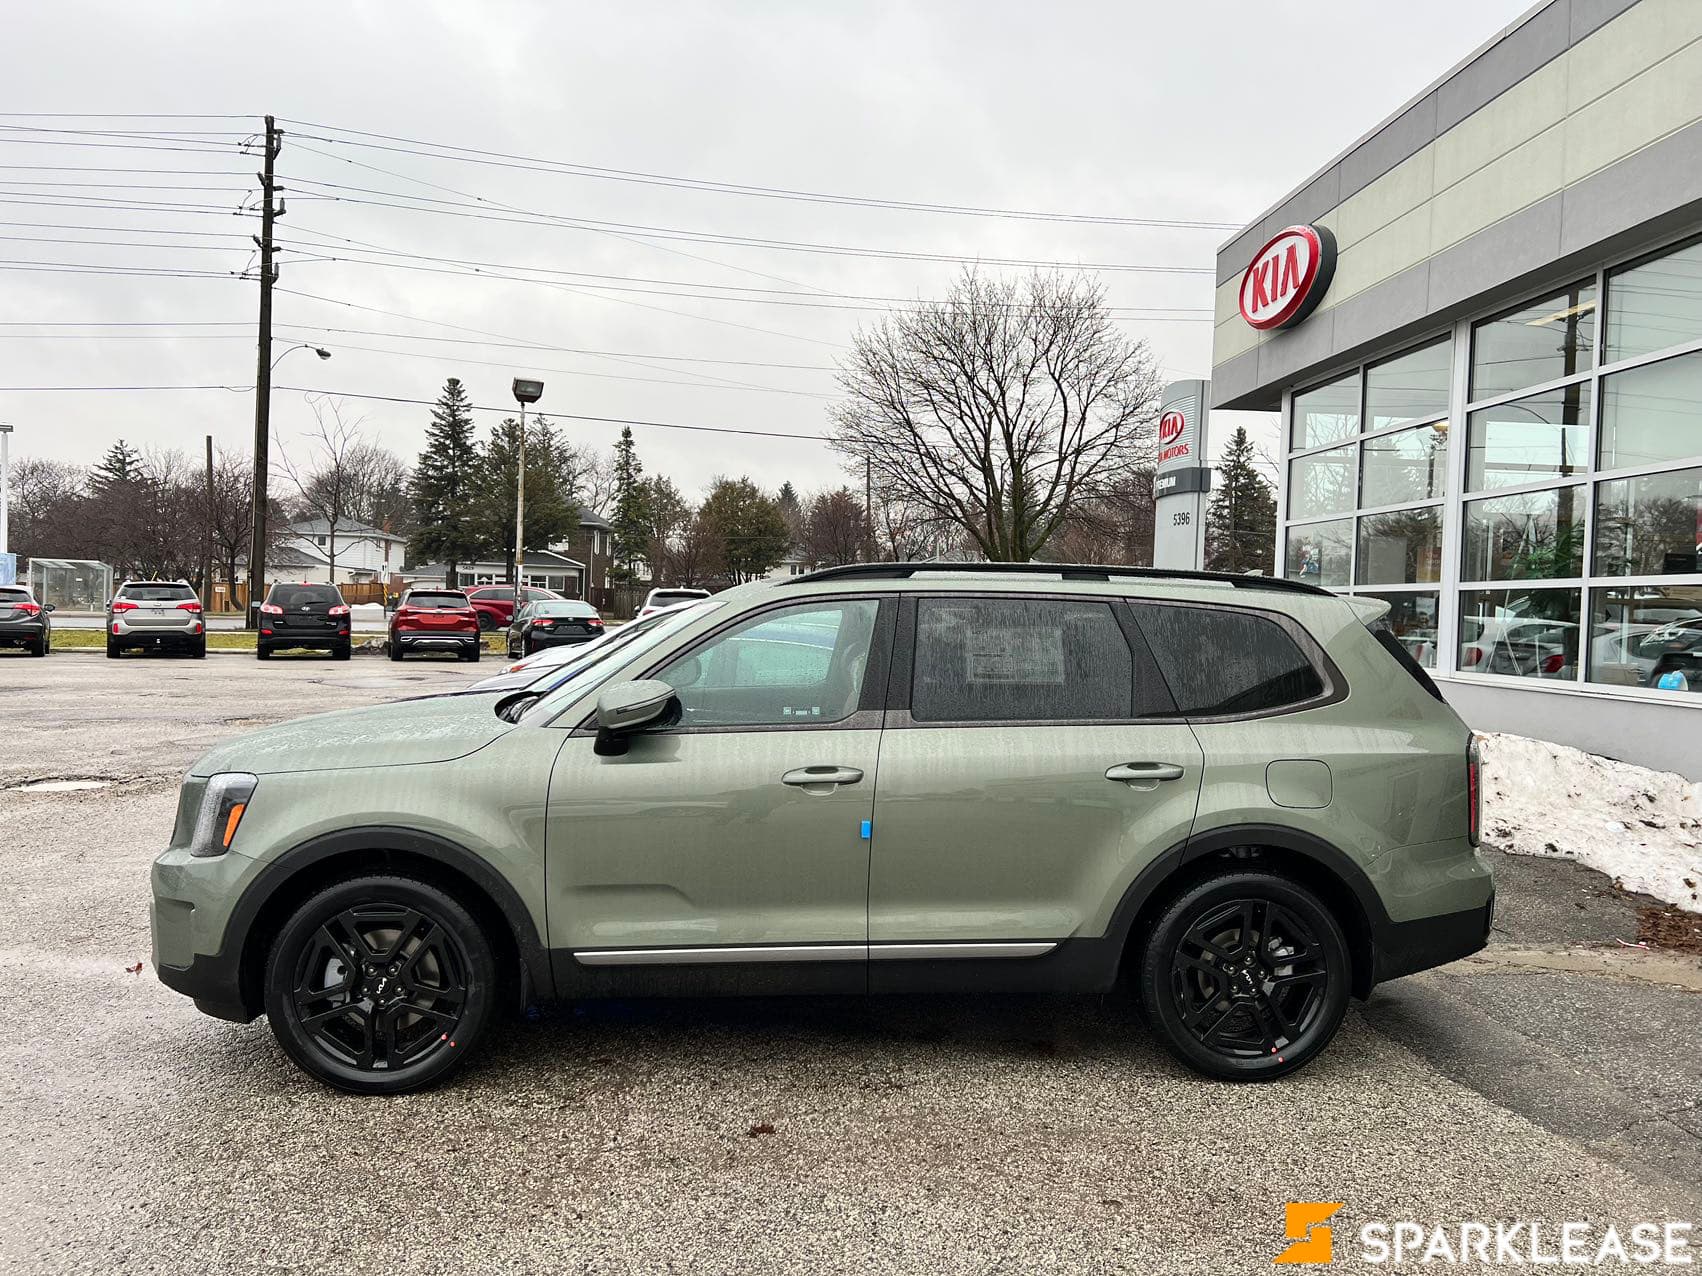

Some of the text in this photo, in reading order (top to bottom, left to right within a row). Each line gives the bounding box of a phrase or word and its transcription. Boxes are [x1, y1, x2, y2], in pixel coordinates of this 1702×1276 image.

[1251, 243, 1300, 314] KIA
[1161, 416, 1179, 440] KIA
[1173, 512, 1190, 526] 5396
